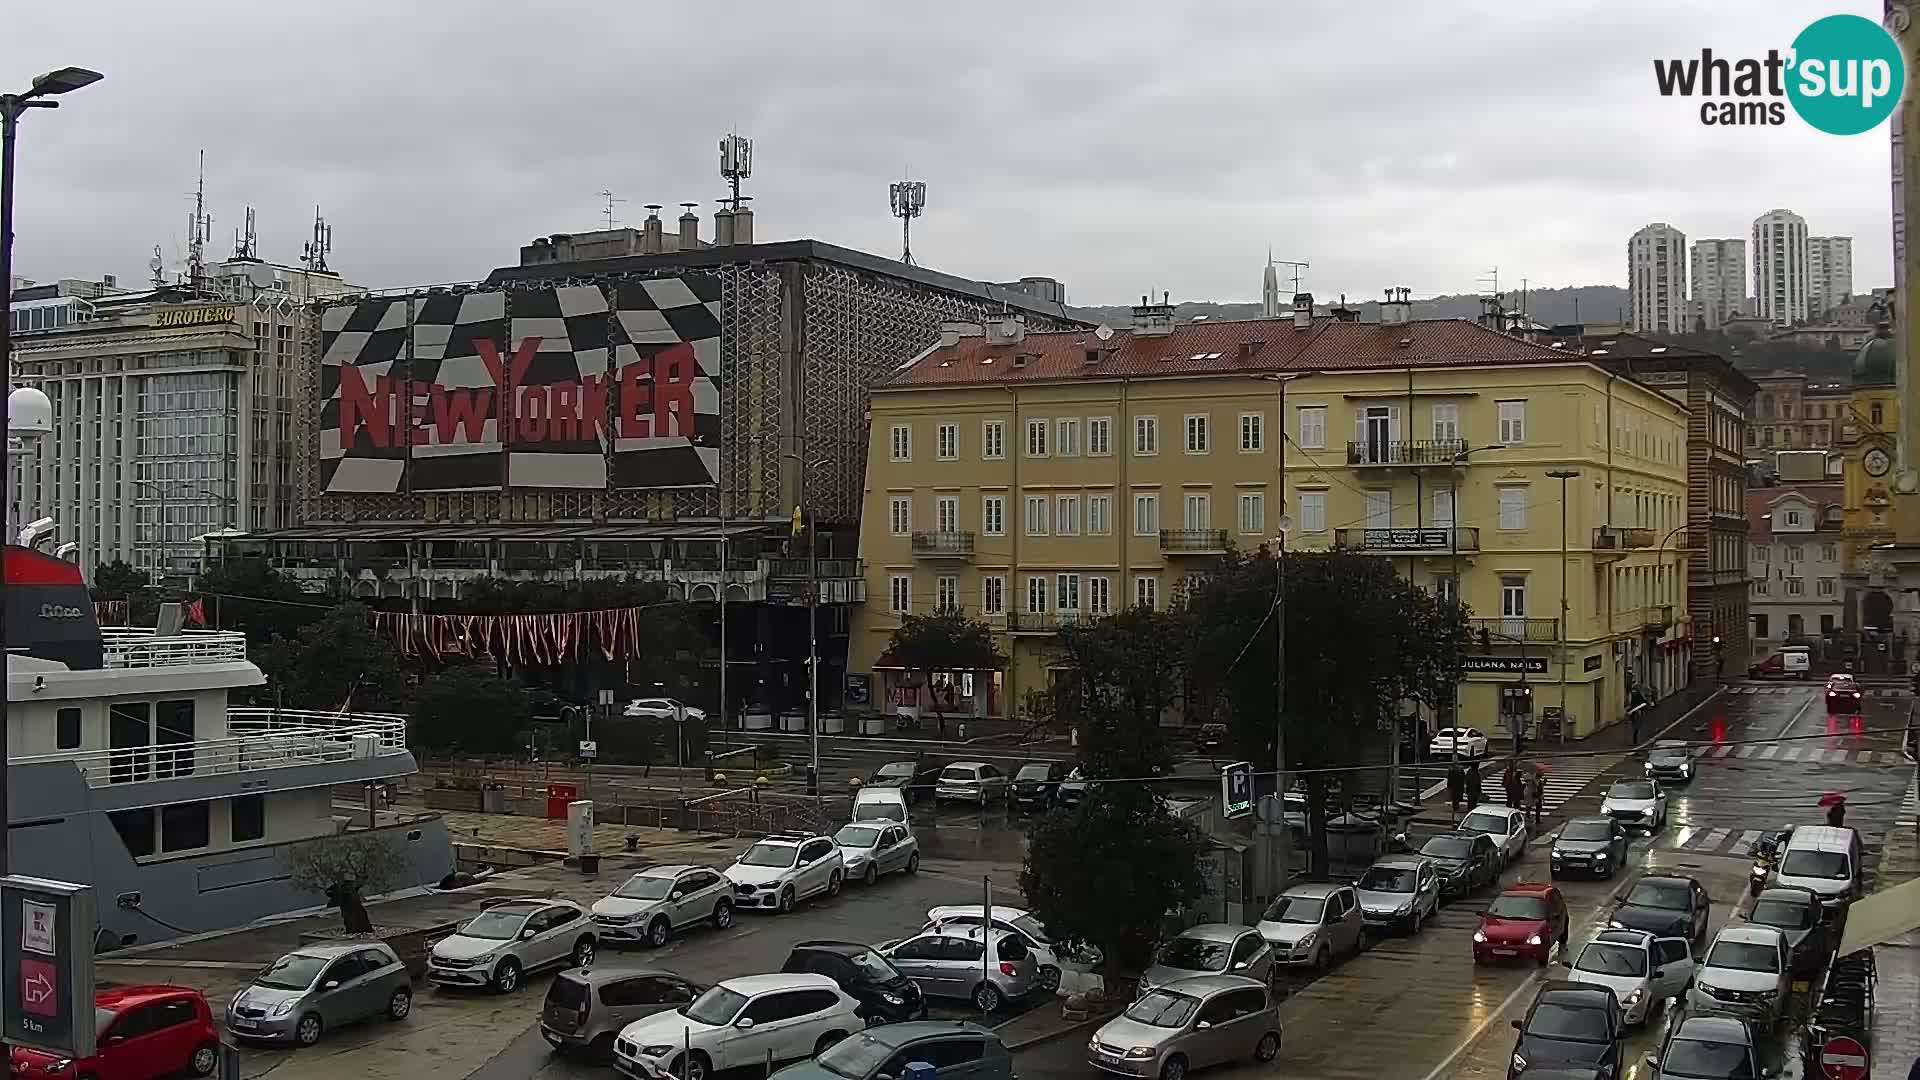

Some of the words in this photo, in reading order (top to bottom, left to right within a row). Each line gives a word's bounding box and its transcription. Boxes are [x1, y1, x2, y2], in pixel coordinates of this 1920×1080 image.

[340, 359, 492, 449] NEW
[1461, 660, 1506, 669] JULIANA
[23, 1018, 29, 1029] 5
[30, 1019, 43, 1033] km
